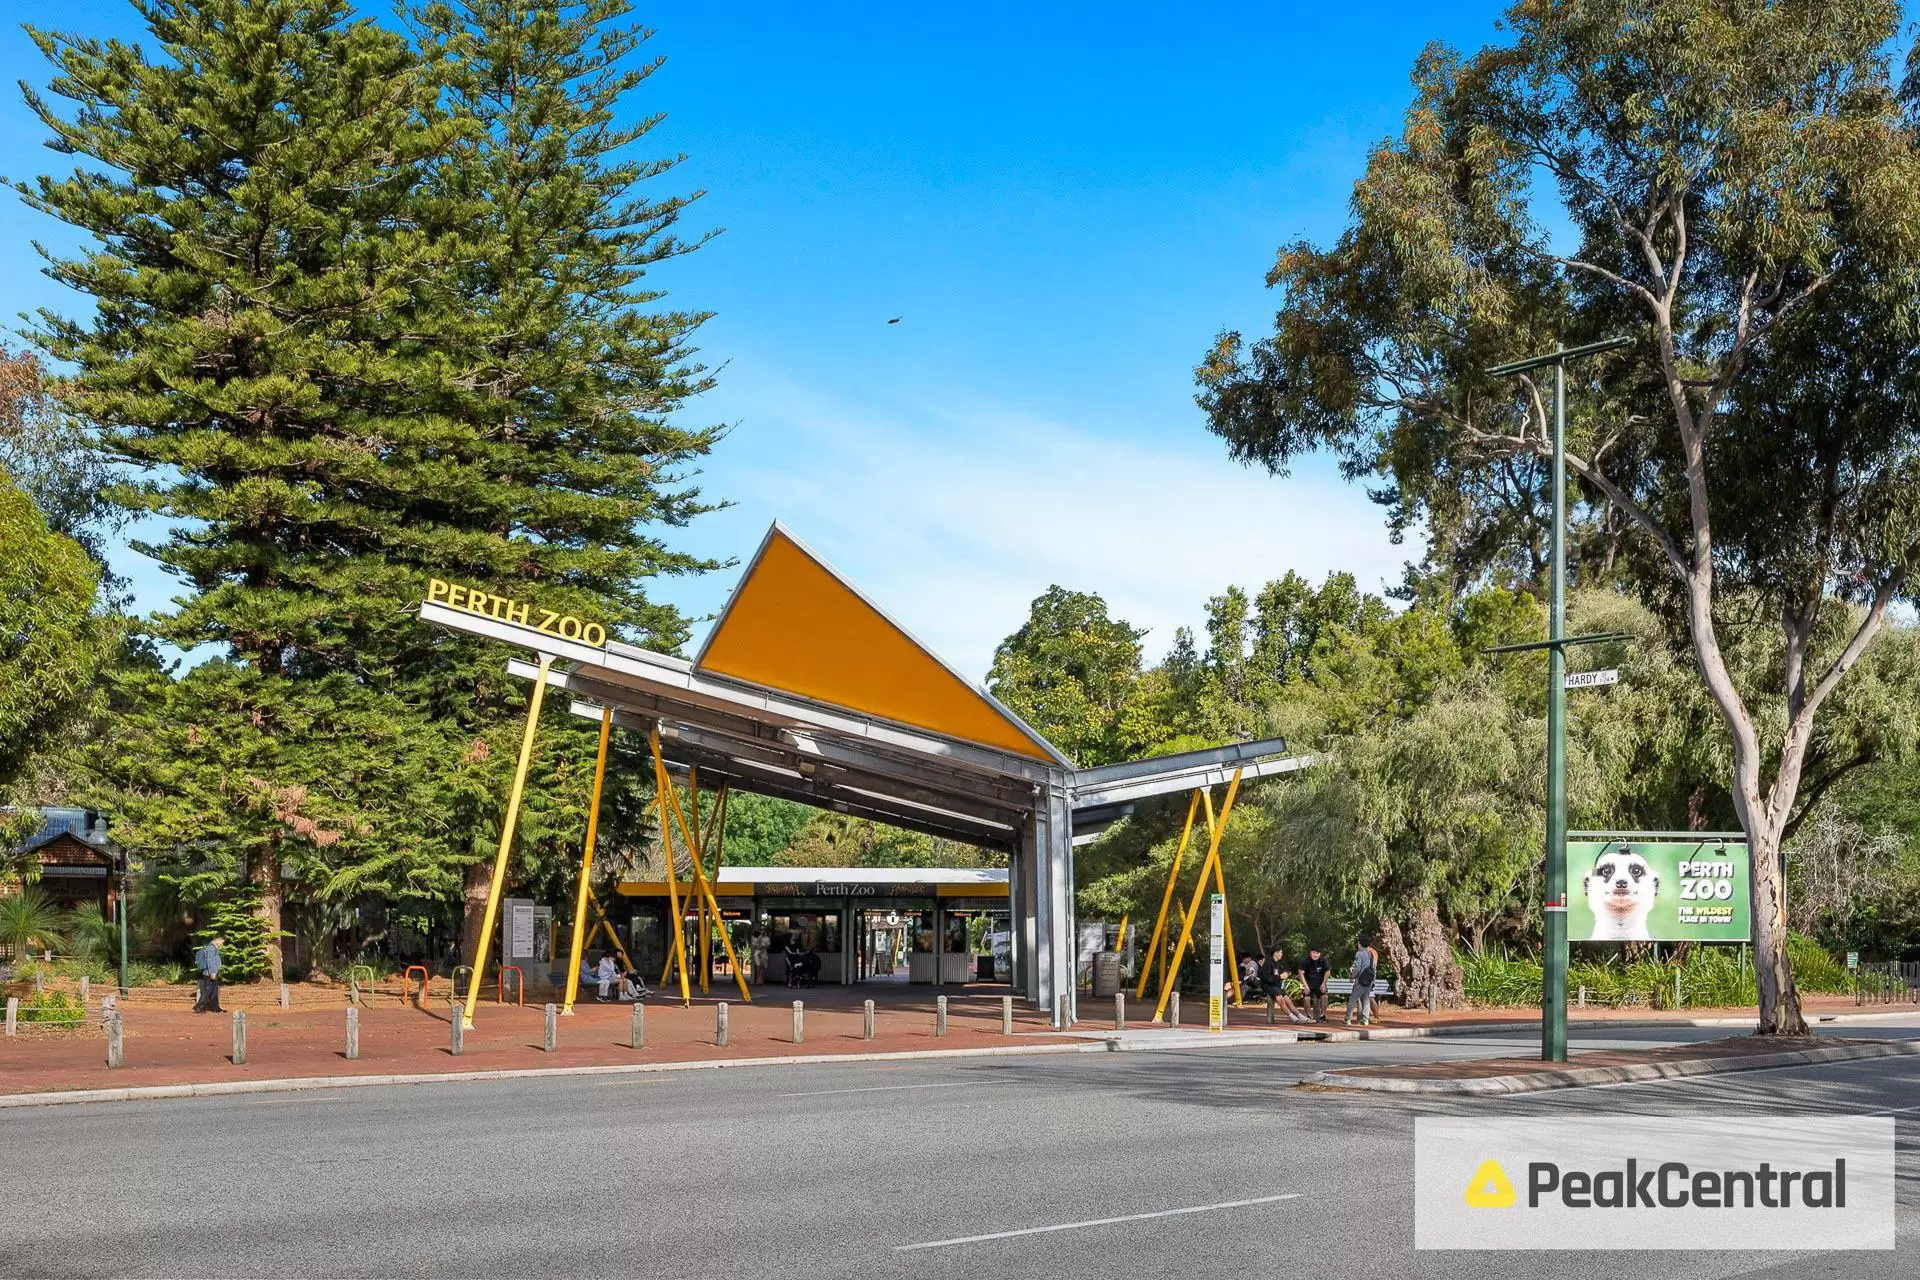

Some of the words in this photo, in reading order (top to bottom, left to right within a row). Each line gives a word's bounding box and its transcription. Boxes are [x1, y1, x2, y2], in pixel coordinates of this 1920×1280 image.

[427, 578, 530, 628] PERTH
[537, 608, 606, 647] ZOO
[1568, 673, 1598, 686] HARDY
[1679, 861, 1734, 878] PERTH
[815, 883, 849, 896] Perth
[850, 884, 875, 896] Zoo
[1680, 879, 1733, 900] ZOO
[1678, 906, 1694, 916] THE
[1695, 906, 1733, 916] WILDEST
[1678, 916, 1699, 924] PLACE
[1699, 916, 1709, 924] IN
